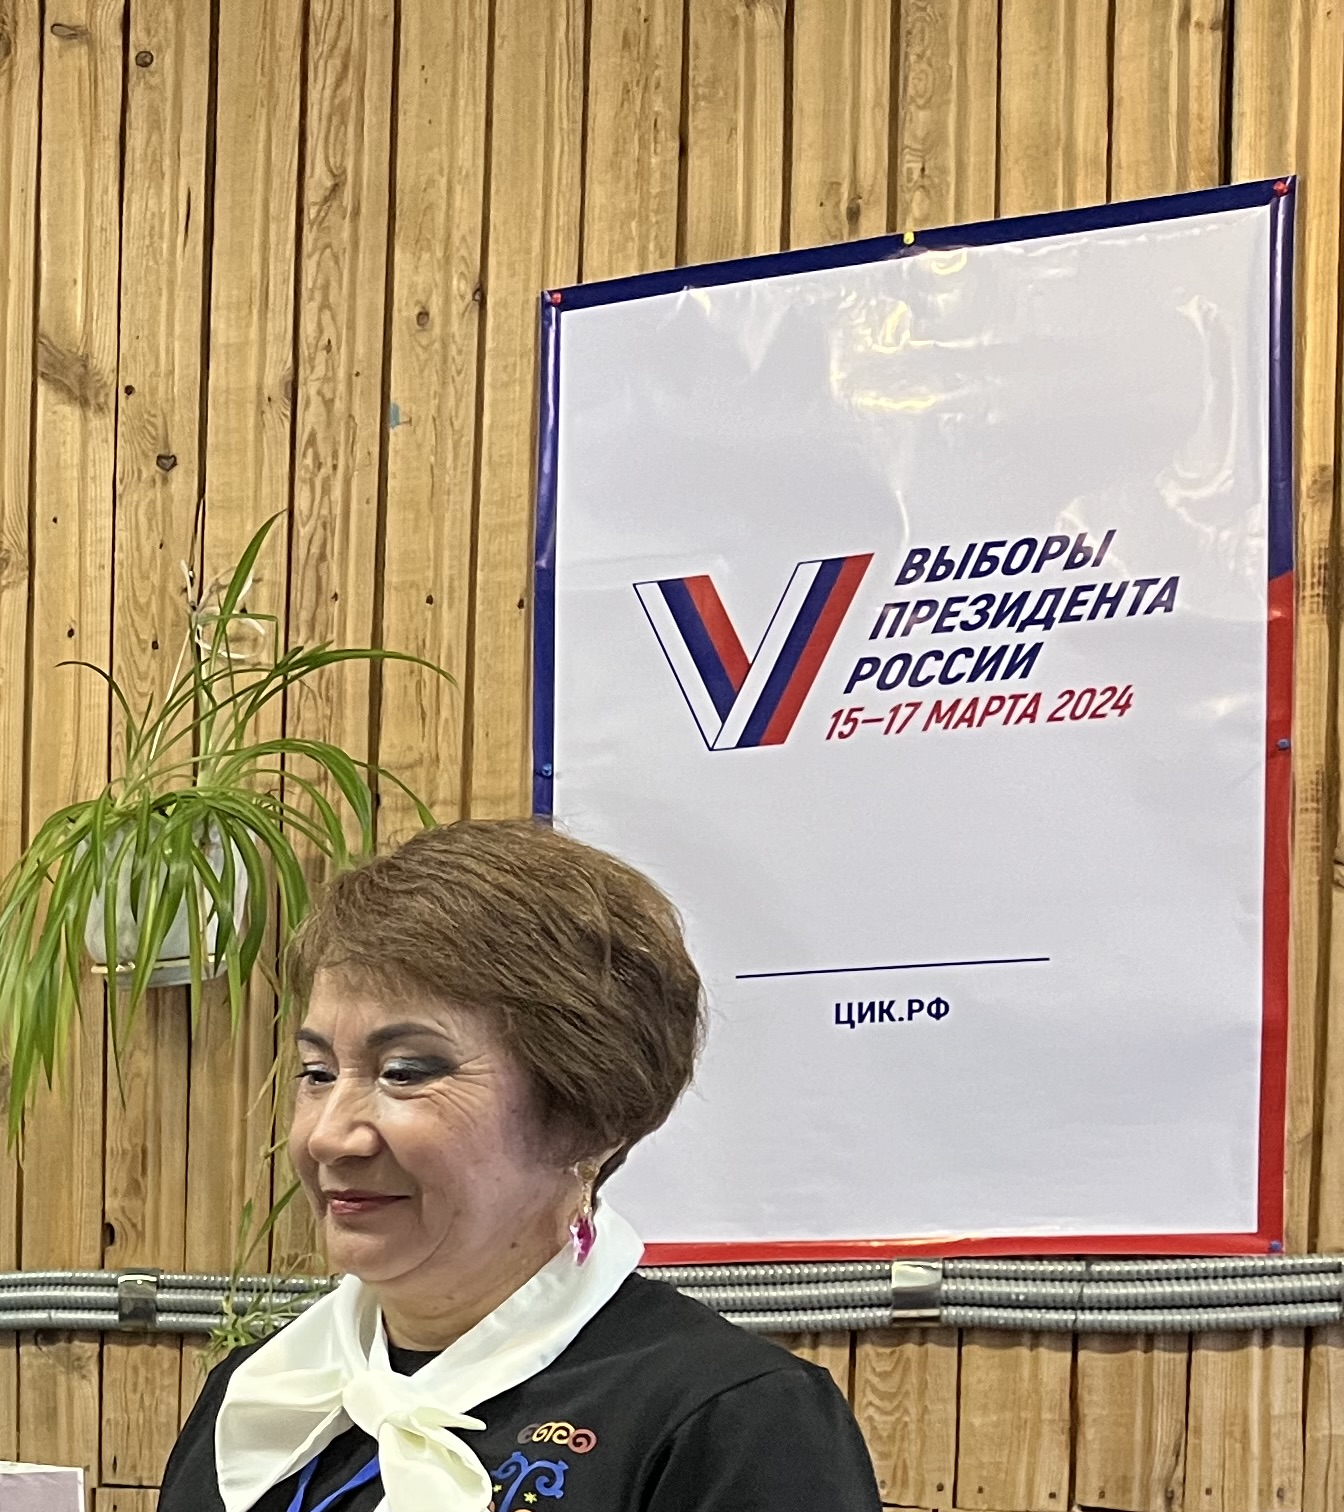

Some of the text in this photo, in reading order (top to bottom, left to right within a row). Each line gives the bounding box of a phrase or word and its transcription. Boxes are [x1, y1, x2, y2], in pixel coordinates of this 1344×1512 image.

[894, 529, 1117, 587] ВЫБОРЫ
[868, 576, 1180, 641] ПРЕЗИДЕНТА
[843, 642, 1044, 695] РОССИИ
[921, 692, 1043, 733] МАРТА
[1046, 684, 1135, 724] 2024
[834, 996, 950, 1029] ЦИК.РФ
